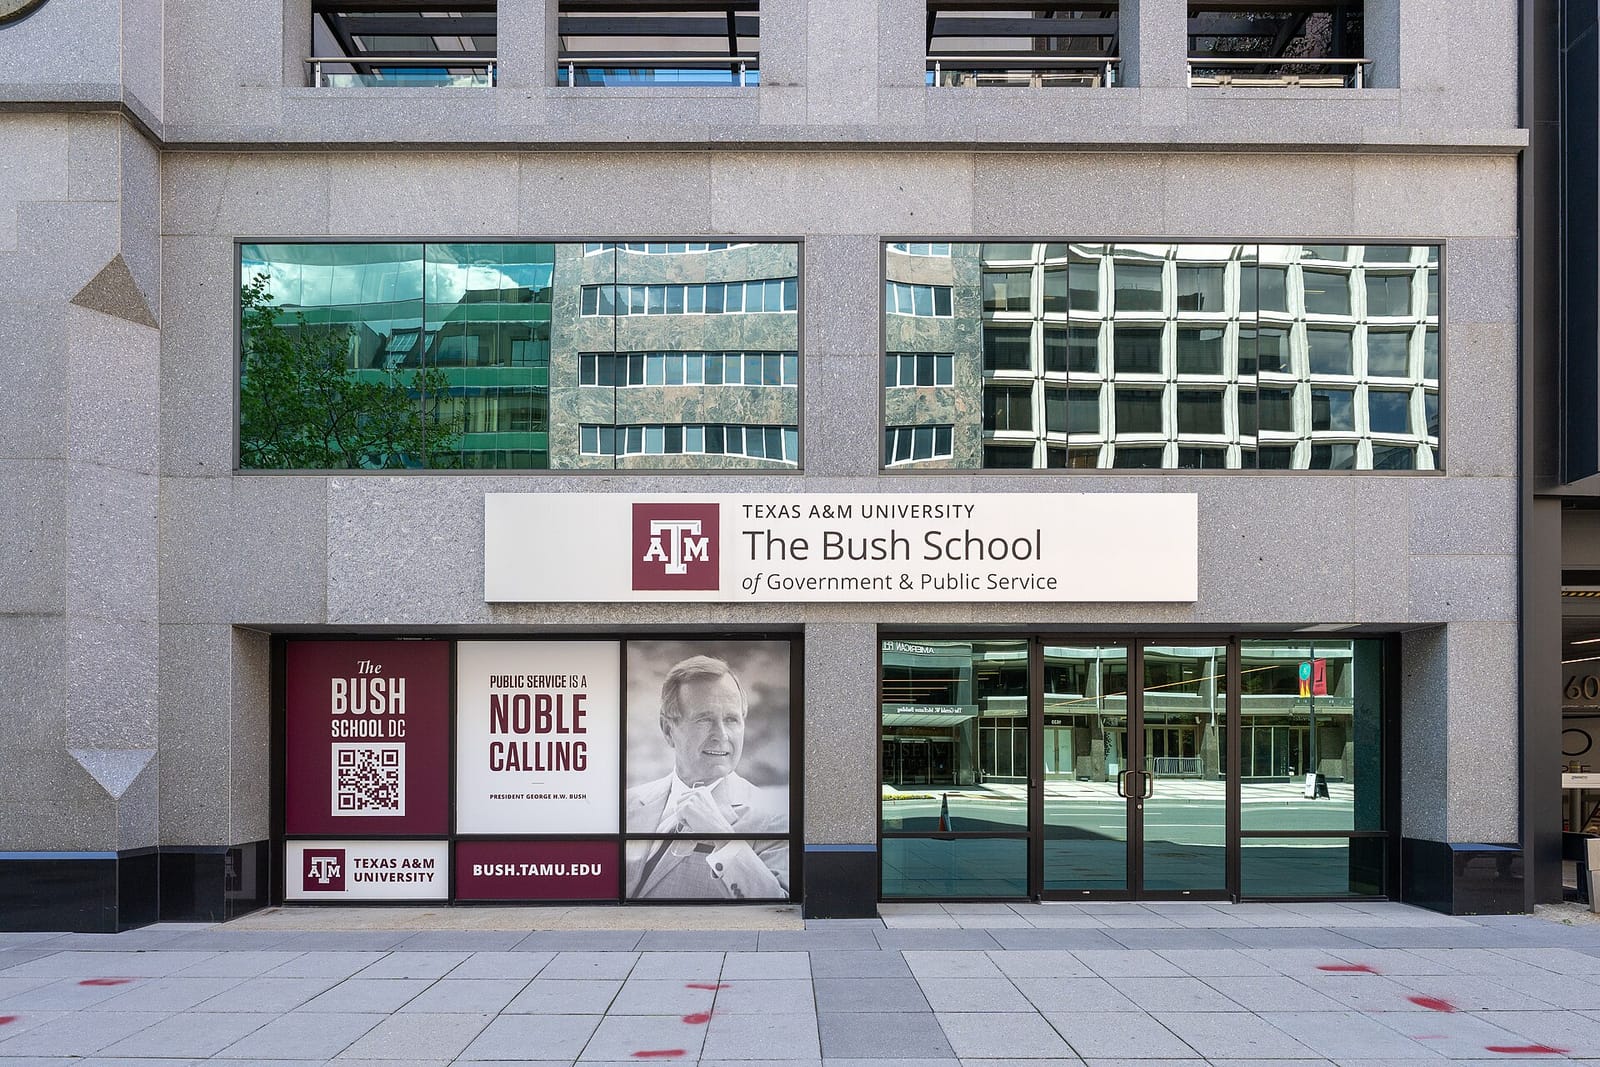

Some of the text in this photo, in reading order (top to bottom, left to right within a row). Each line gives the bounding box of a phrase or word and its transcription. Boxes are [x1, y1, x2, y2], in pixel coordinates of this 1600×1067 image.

[742, 505, 975, 519] TEXAS A&M UNIVERSITY
[742, 528, 1041, 561] The Bush School
[742, 572, 1058, 595] of Government & Public Service
[357, 660, 382, 674] The
[490, 675, 588, 688] PUBLIC SERVICE IS A
[331, 678, 406, 714] BUSH
[490, 694, 587, 734] NOBLE
[331, 719, 406, 737] SCHOOL DC
[489, 741, 587, 771] CALLING
[353, 858, 435, 869] TEXAS A&M
[473, 864, 602, 876] BUSH.TAMU.EDU
[353, 872, 435, 882] UNIVERSITY
